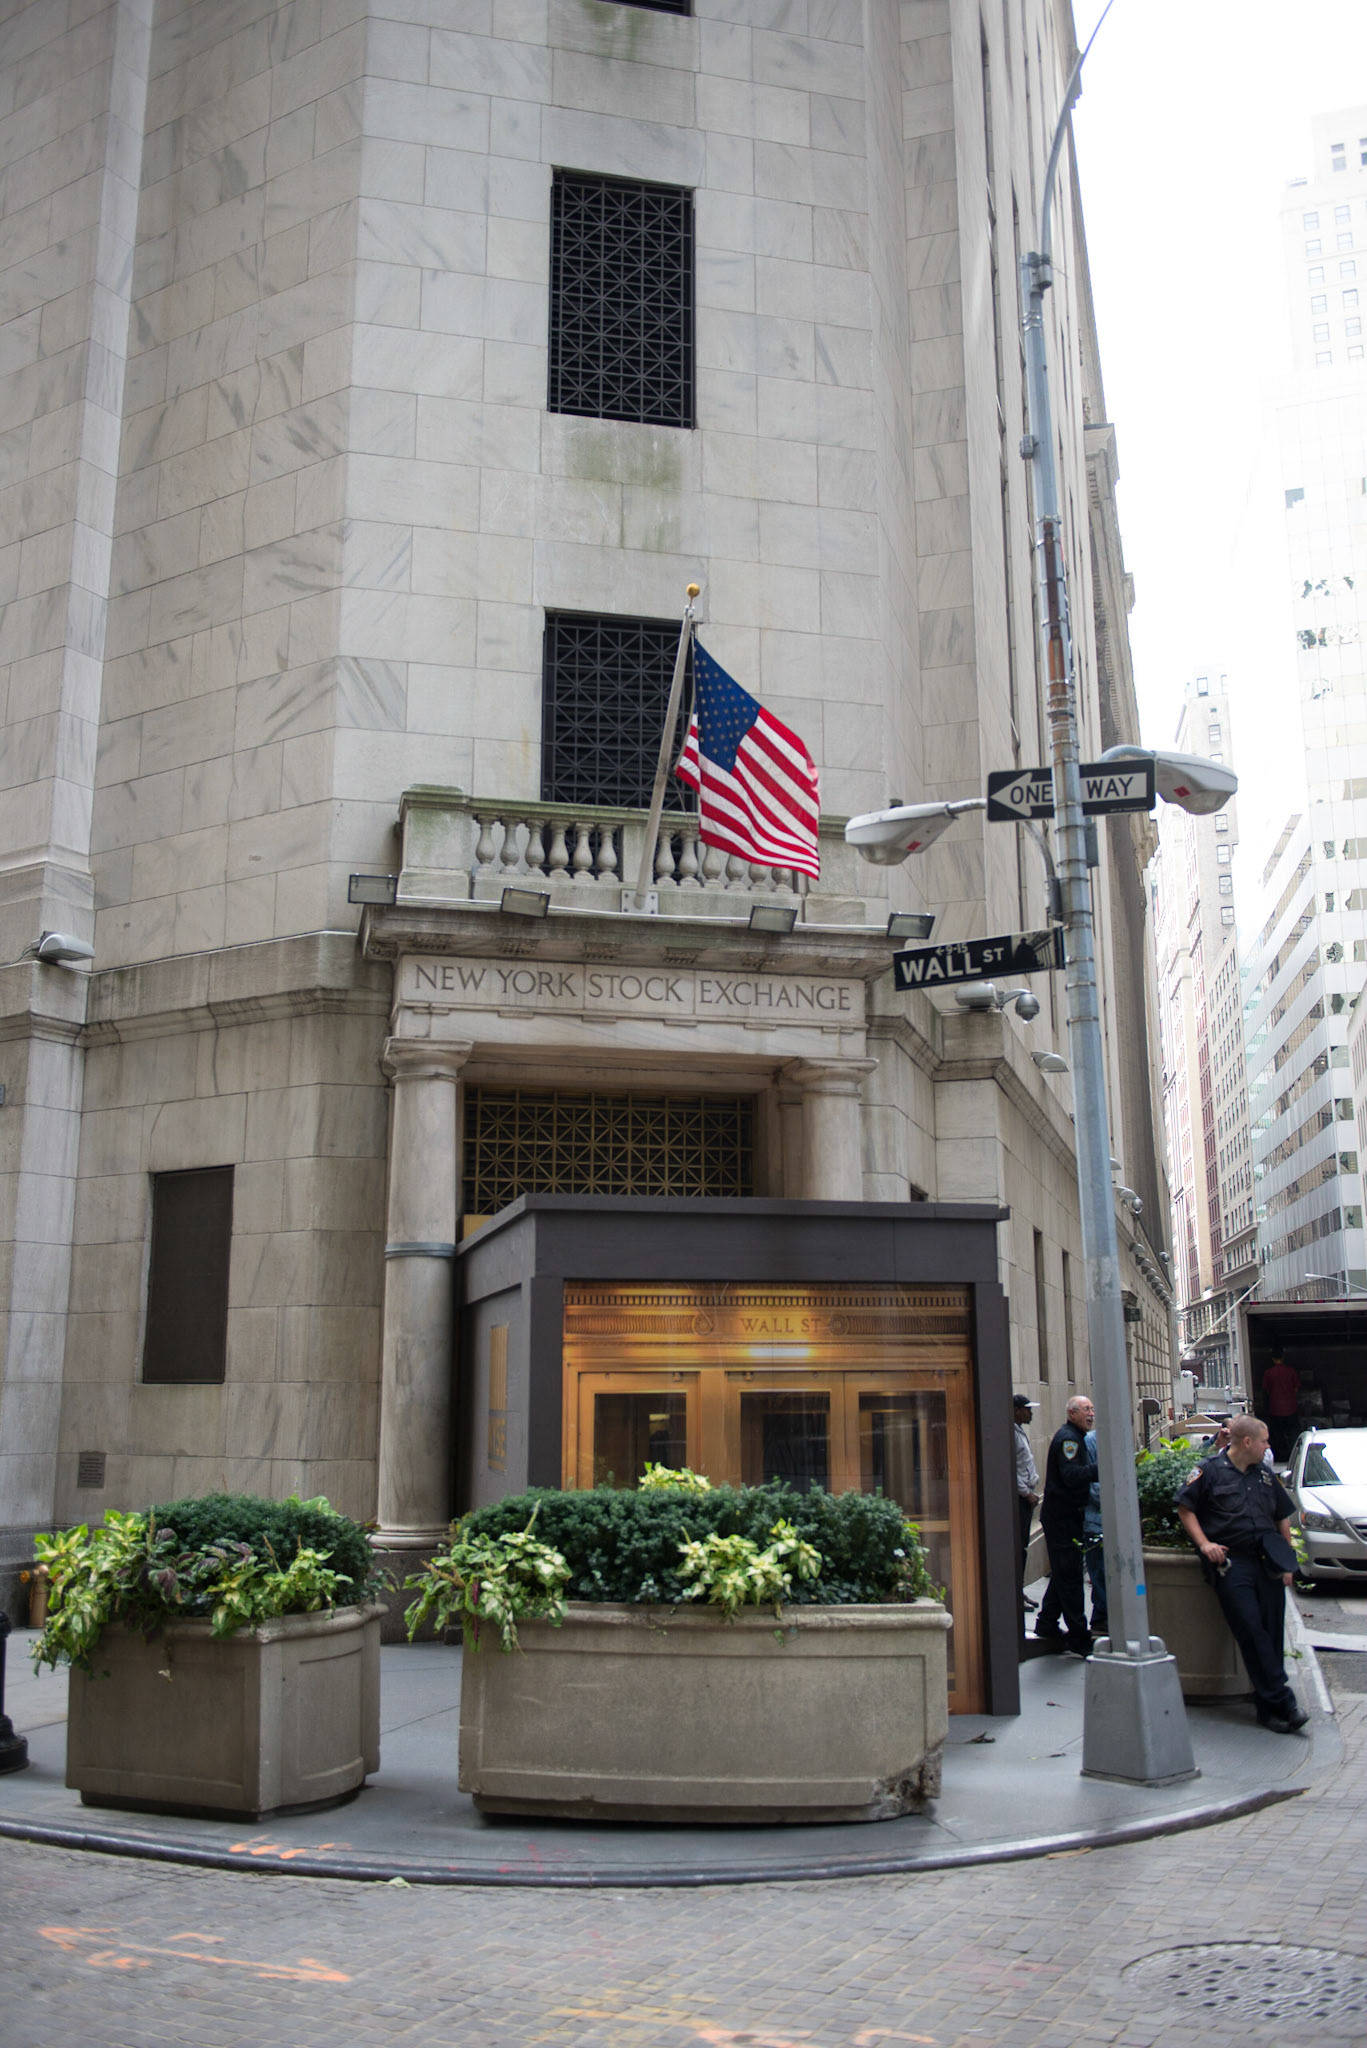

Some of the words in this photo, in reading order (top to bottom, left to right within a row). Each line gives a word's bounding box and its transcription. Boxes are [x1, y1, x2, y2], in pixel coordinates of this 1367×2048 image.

[1010, 783, 1052, 805] ONE
[1086, 776, 1134, 799] WAY
[901, 952, 982, 984] WALL
[983, 947, 1005, 963] ST
[415, 964, 487, 991] NEW
[496, 968, 577, 998] YORK
[588, 973, 684, 1002] STOCK
[700, 979, 852, 1011] EXCHANGE
[740, 1317, 794, 1333] WALL
[801, 1318, 821, 1333] ST
